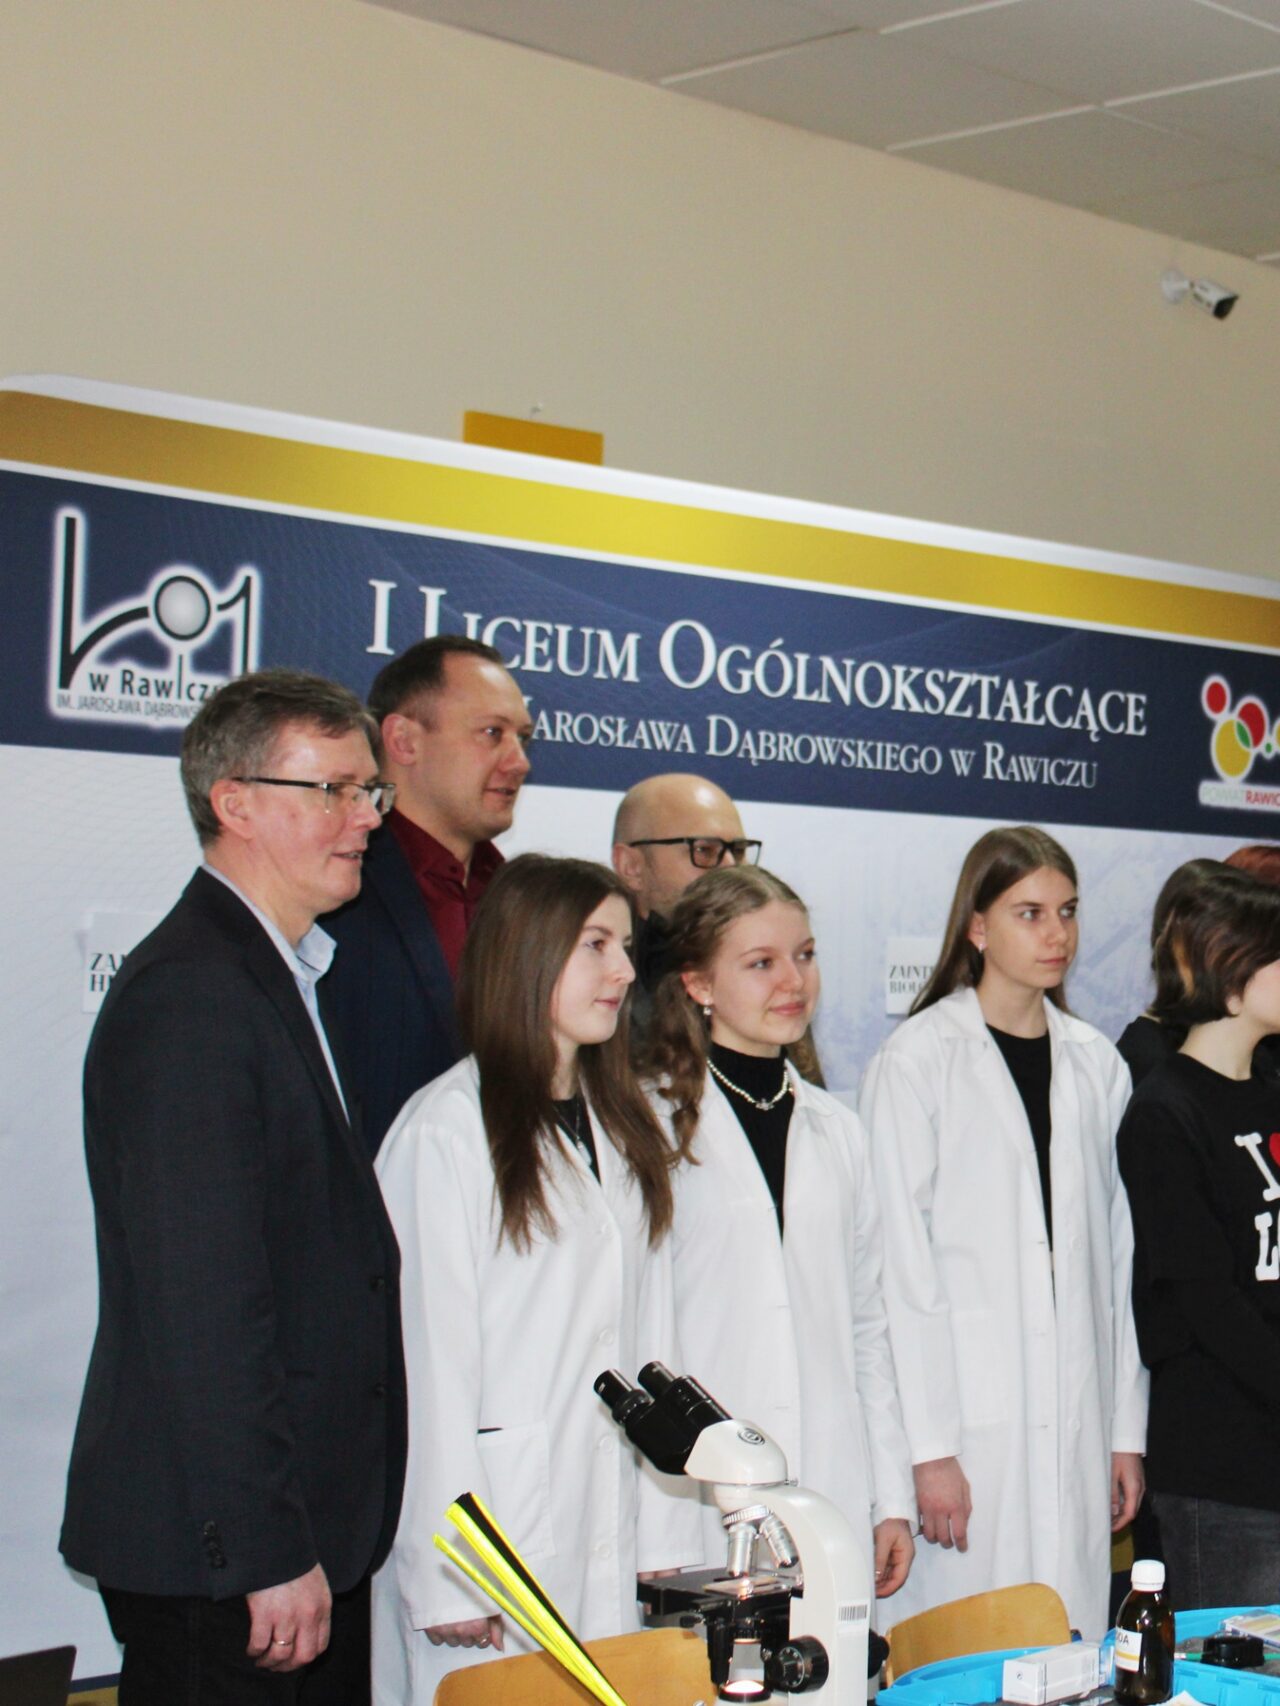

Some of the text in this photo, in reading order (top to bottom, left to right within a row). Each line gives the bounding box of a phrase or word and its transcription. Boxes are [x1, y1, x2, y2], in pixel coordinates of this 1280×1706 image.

[366, 578, 398, 656] I
[658, 618, 1148, 743] OGÓLNOKSZTAŁCĄCE
[522, 695, 697, 756] AROSŁAWA
[705, 713, 943, 776] DĄBROWSKIEGO
[982, 741, 1099, 789] RAWICZU
